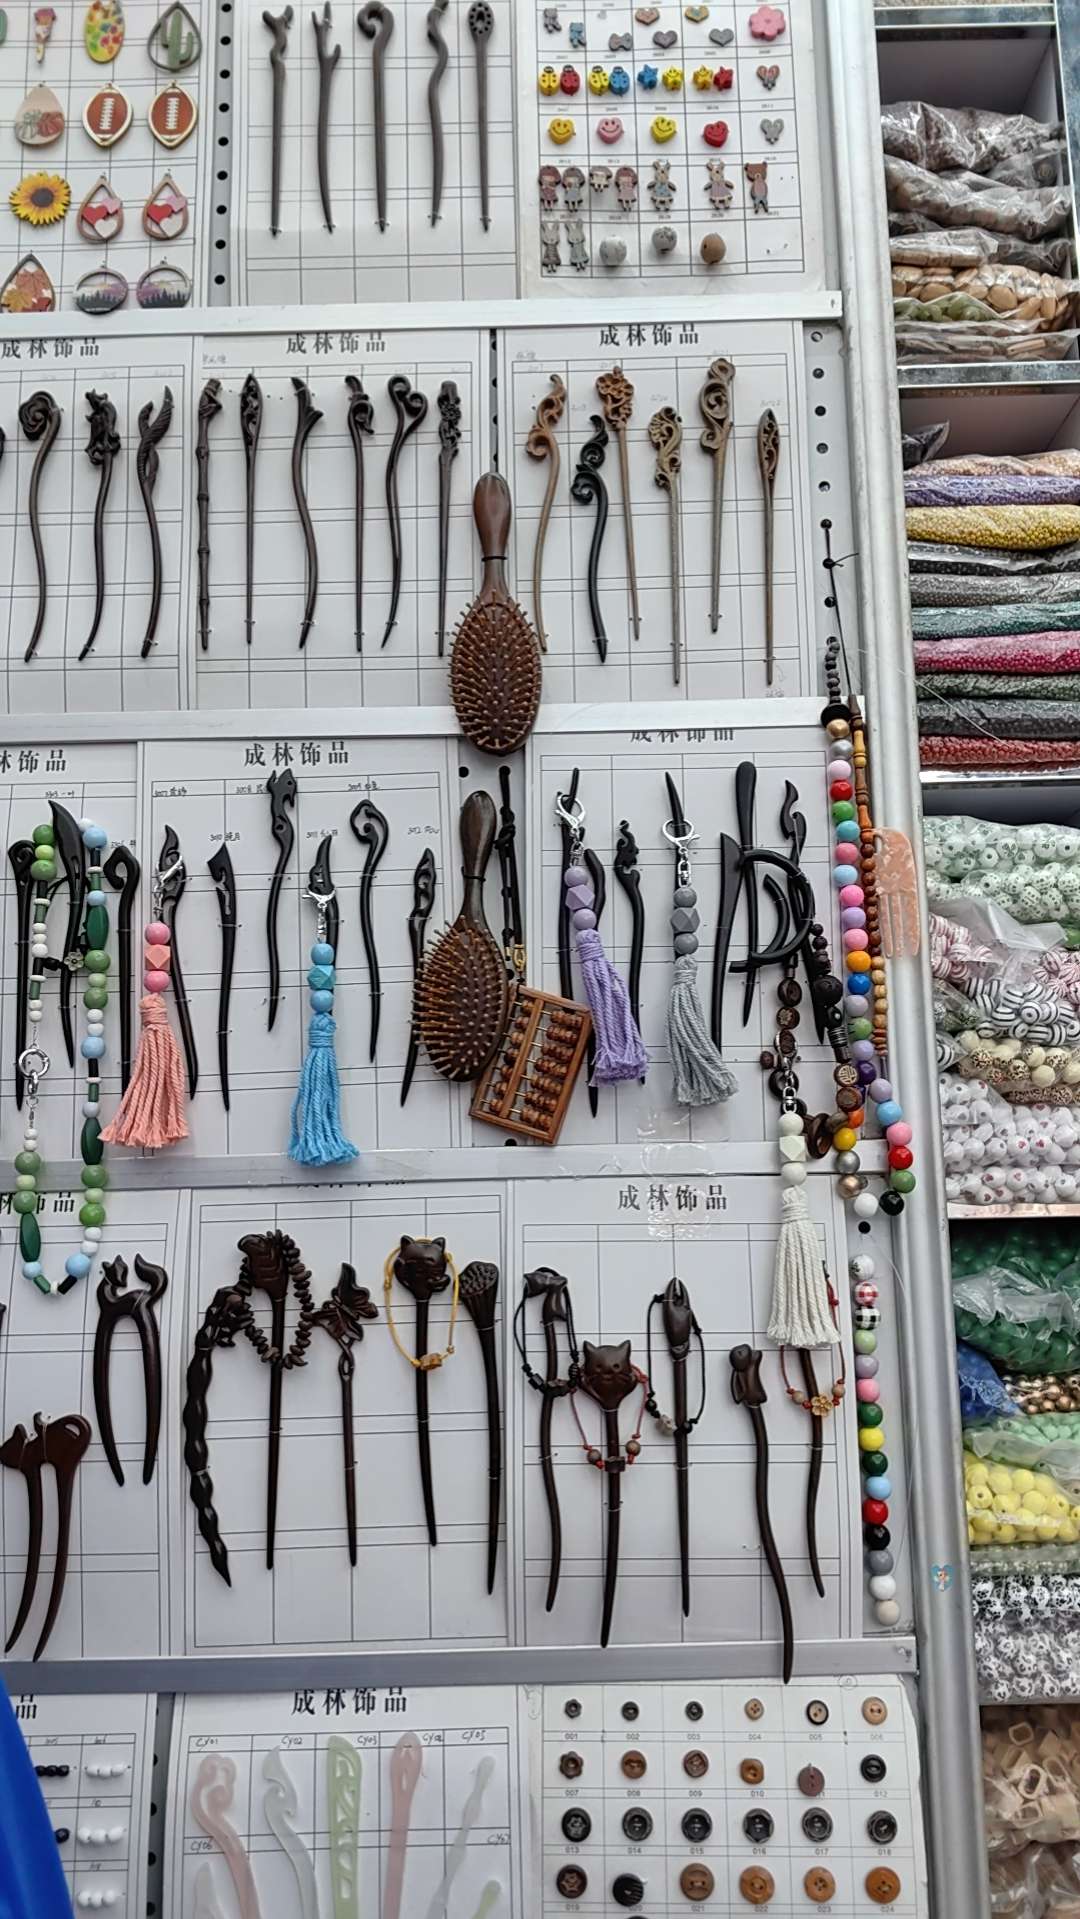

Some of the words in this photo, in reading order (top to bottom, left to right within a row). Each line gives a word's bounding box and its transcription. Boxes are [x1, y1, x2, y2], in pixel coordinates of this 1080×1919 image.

[286, 332, 386, 354] 成林饰品
[600, 323, 699, 346] 成林饰品
[0, 337, 99, 359] 成林饰品
[244, 741, 348, 767] 成林饰品
[617, 1184, 727, 1211] 成林饰品
[292, 1687, 407, 1715] 成林饰品
